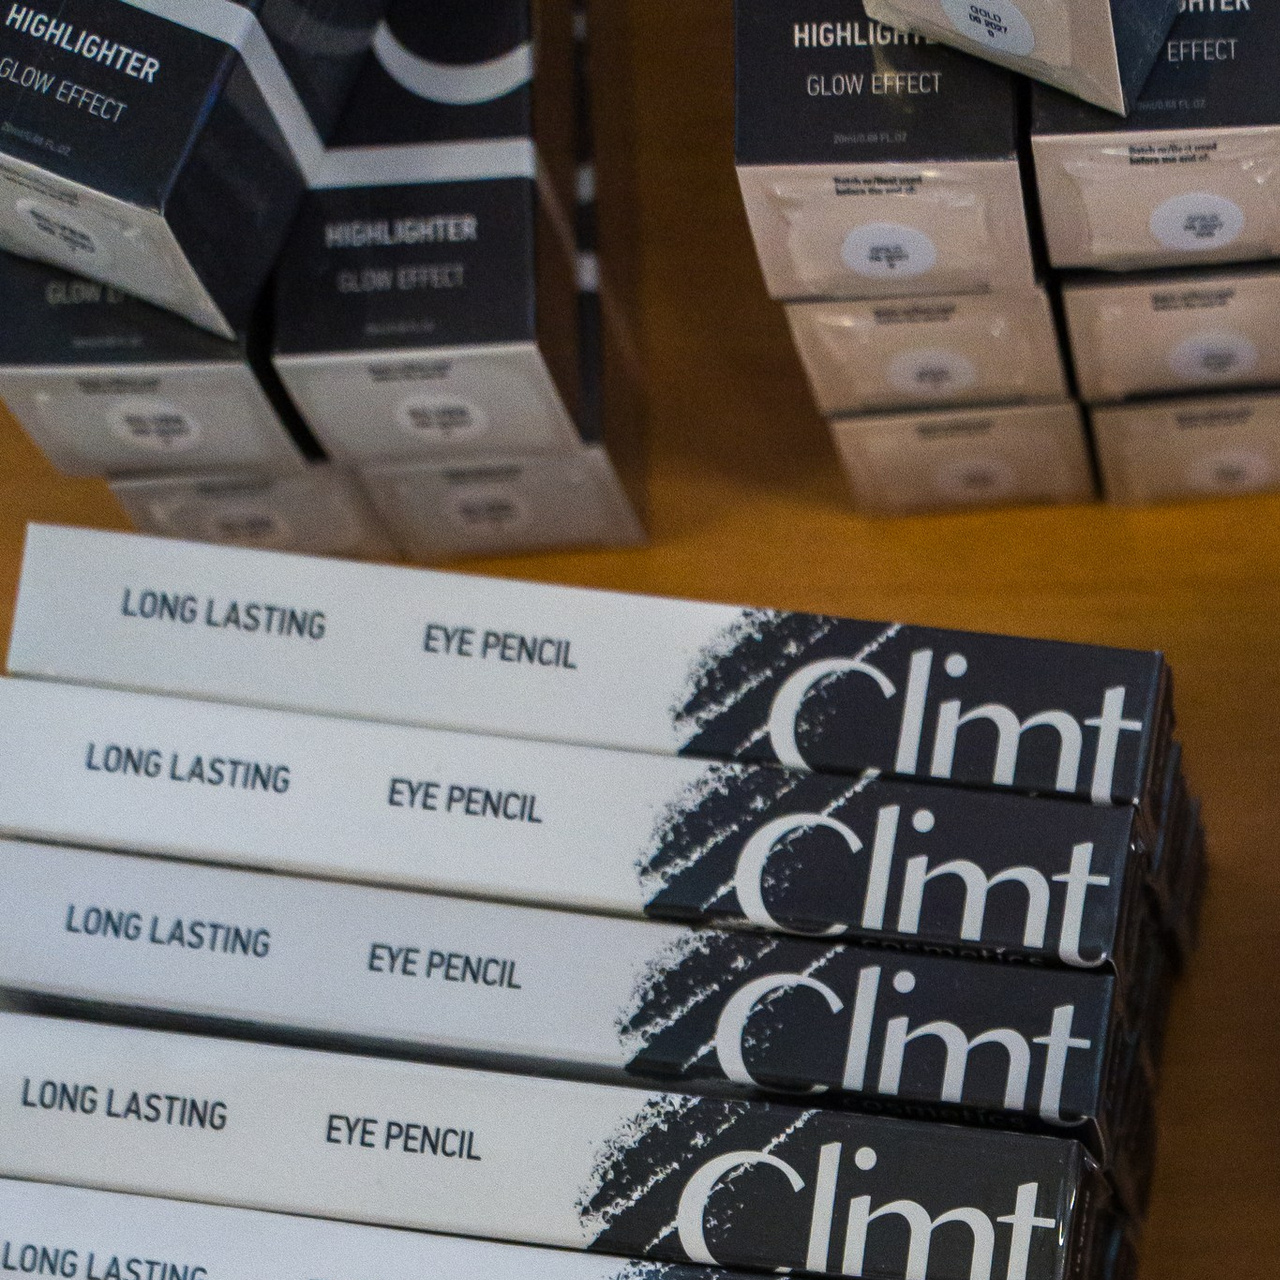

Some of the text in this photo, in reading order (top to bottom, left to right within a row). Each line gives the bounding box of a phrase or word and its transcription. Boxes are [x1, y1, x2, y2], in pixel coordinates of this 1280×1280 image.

[5, 3, 160, 83] HIGHLIGHTER
[1167, 39, 1238, 62] EFFECT
[0, 58, 128, 122] GLOW EFFECT
[806, 72, 943, 97] GLOW EFFECT
[325, 215, 478, 248] HIGHLIGHTER
[121, 588, 327, 640] LONG LASTING
[423, 623, 579, 669] EYE PENCIL
[768, 648, 1143, 806] Climt
[85, 743, 291, 795] LONG LASTING
[388, 777, 544, 824] EYE PENCIL
[735, 804, 1111, 968] Climt
[65, 903, 271, 959] LONG LASTING
[367, 943, 523, 991] EYE PENCIL
[716, 966, 1091, 1126] Climt
[20, 1077, 229, 1132] LONG LASTING
[325, 1114, 482, 1162] EYE PENCIL
[2, 1240, 79, 1278] LONG
